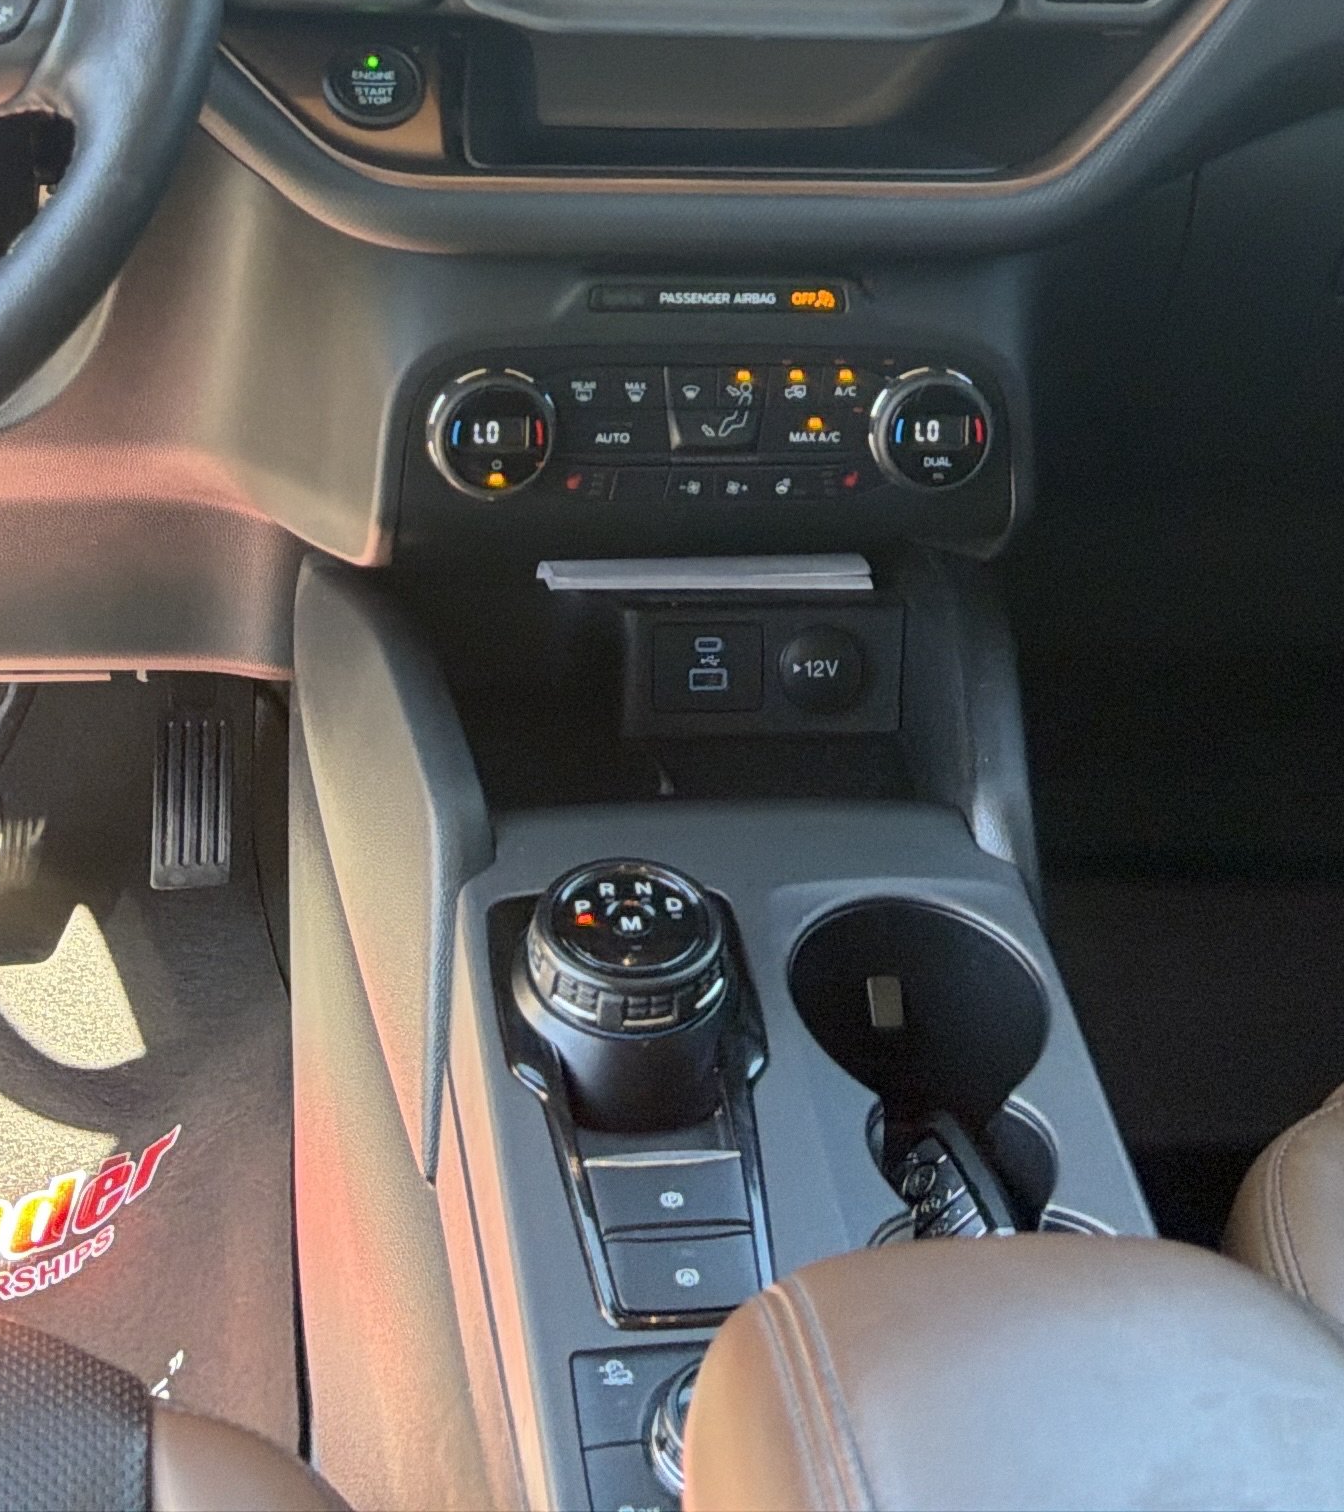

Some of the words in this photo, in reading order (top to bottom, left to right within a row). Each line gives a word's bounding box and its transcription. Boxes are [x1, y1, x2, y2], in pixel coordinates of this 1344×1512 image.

[351, 70, 396, 81] ENGINE
[354, 86, 395, 96] START
[357, 95, 393, 105] STOP
[659, 291, 731, 305] PASSENGER
[733, 292, 777, 305] AIRBAG
[791, 291, 816, 307] OFF
[570, 380, 597, 390] REAR
[624, 381, 647, 390] MAX
[834, 386, 857, 398] A/C
[473, 420, 500, 444] LO
[788, 431, 817, 443] MAX
[818, 431, 842, 443] A/C
[914, 419, 940, 443] LO
[595, 432, 631, 445] AUTO
[923, 455, 953, 468] DUAL
[804, 658, 839, 679] 12V
[598, 881, 616, 897] R
[634, 881, 654, 896] N
[574, 899, 592, 914] P
[665, 897, 684, 913] D
[620, 915, 644, 932] M
